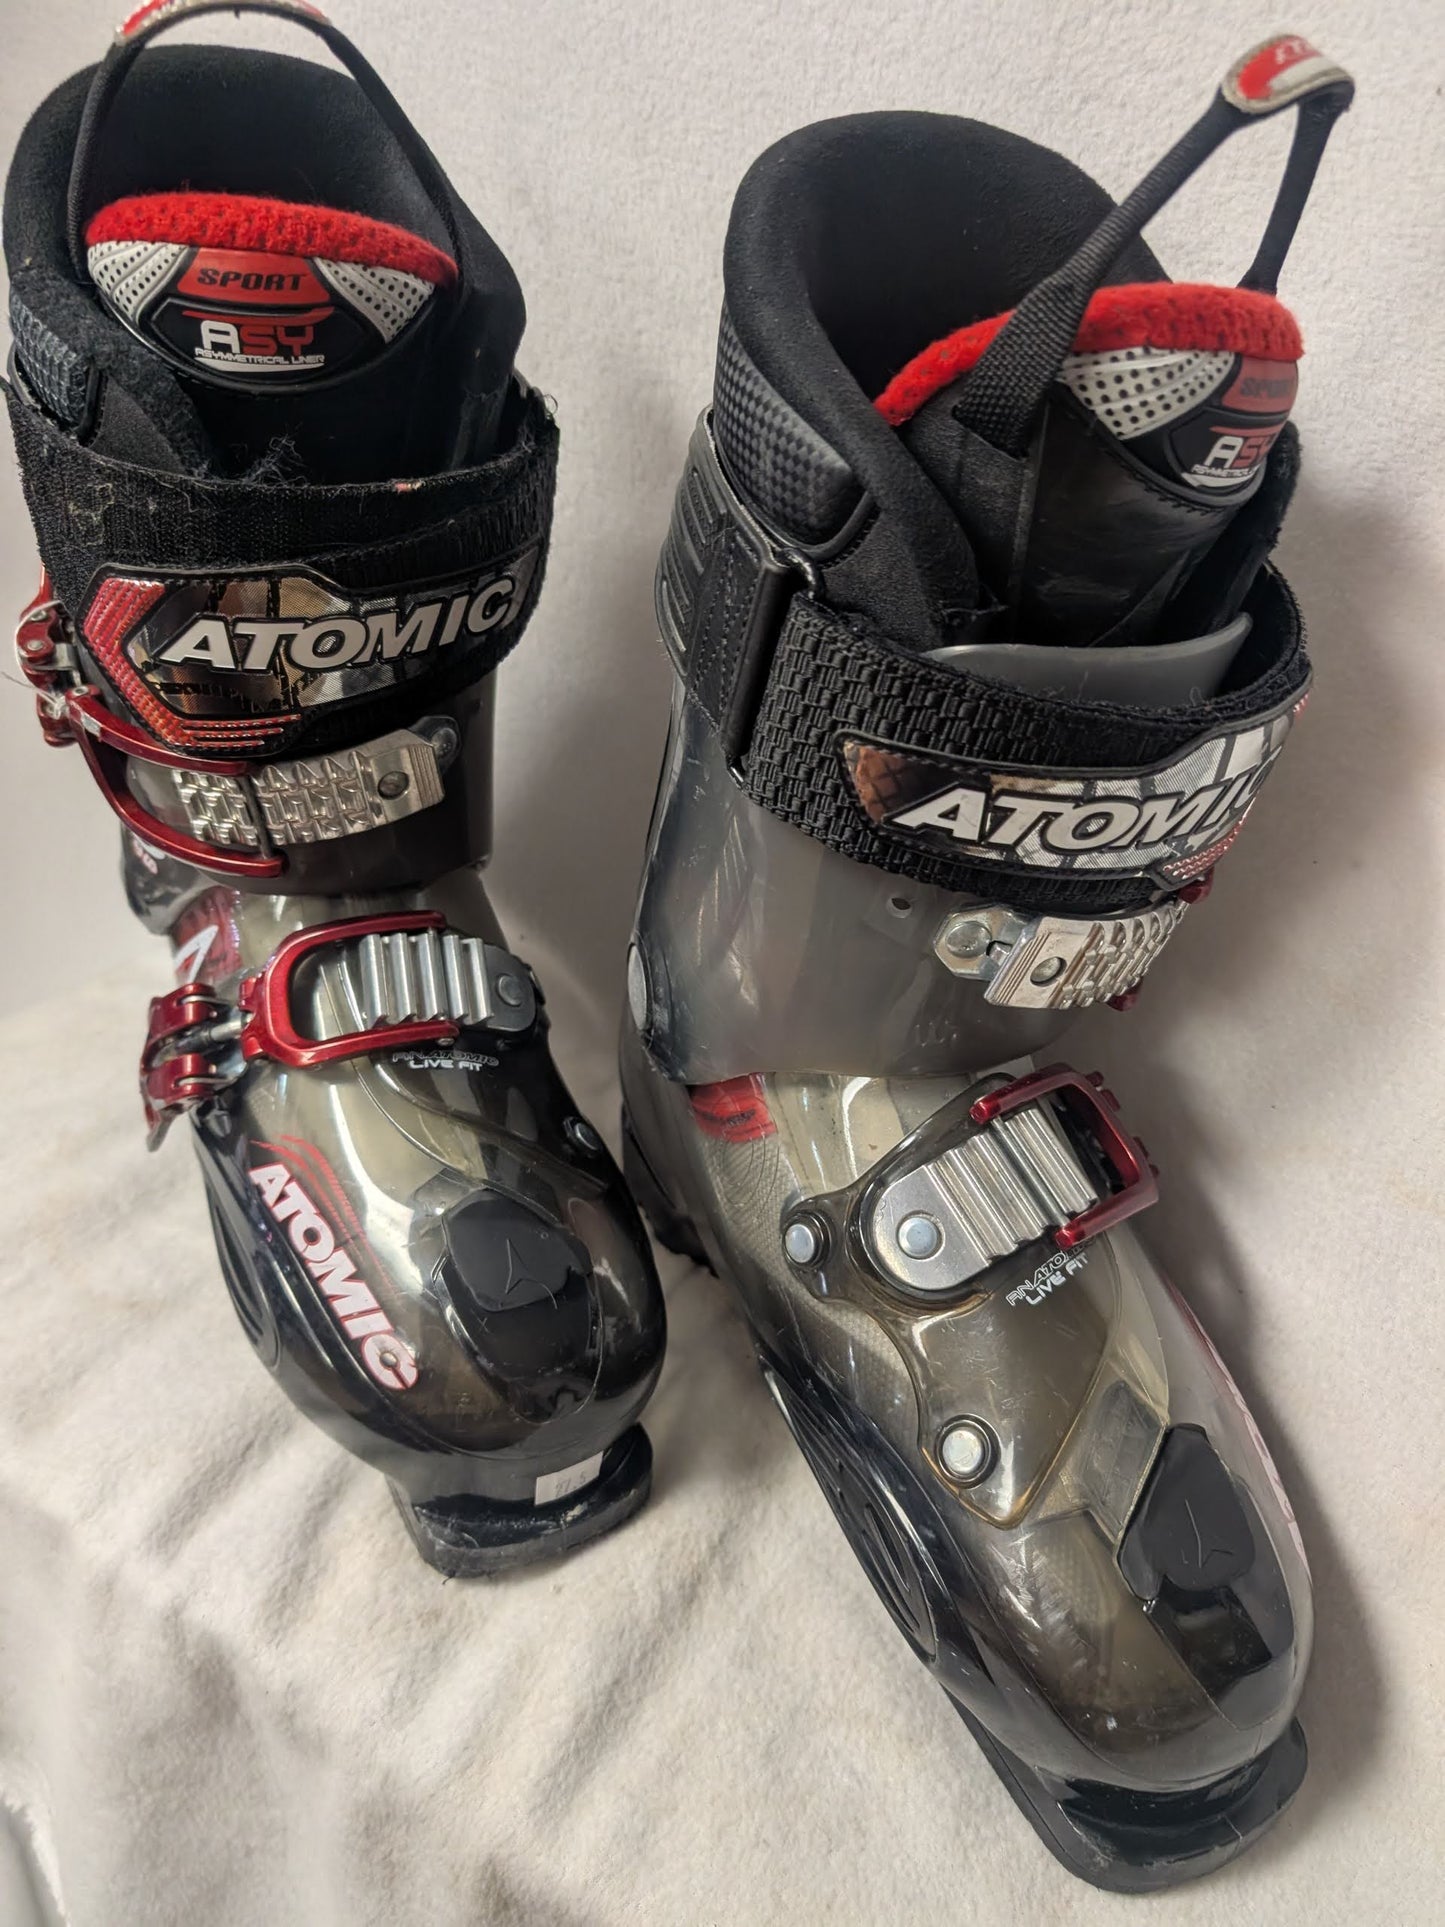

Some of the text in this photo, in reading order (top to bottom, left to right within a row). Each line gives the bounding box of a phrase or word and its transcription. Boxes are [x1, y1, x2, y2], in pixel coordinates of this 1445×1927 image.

[197, 267, 308, 291] SPORT
[194, 346, 326, 365] ASYMMETRICAL LINER
[200, 319, 315, 356] ASY
[156, 578, 515, 671] ATOMIC
[408, 1059, 483, 1071] LIVE FIT
[249, 1162, 419, 1390] ATOMIC
[1025, 1252, 1088, 1305] LIVE FIT
